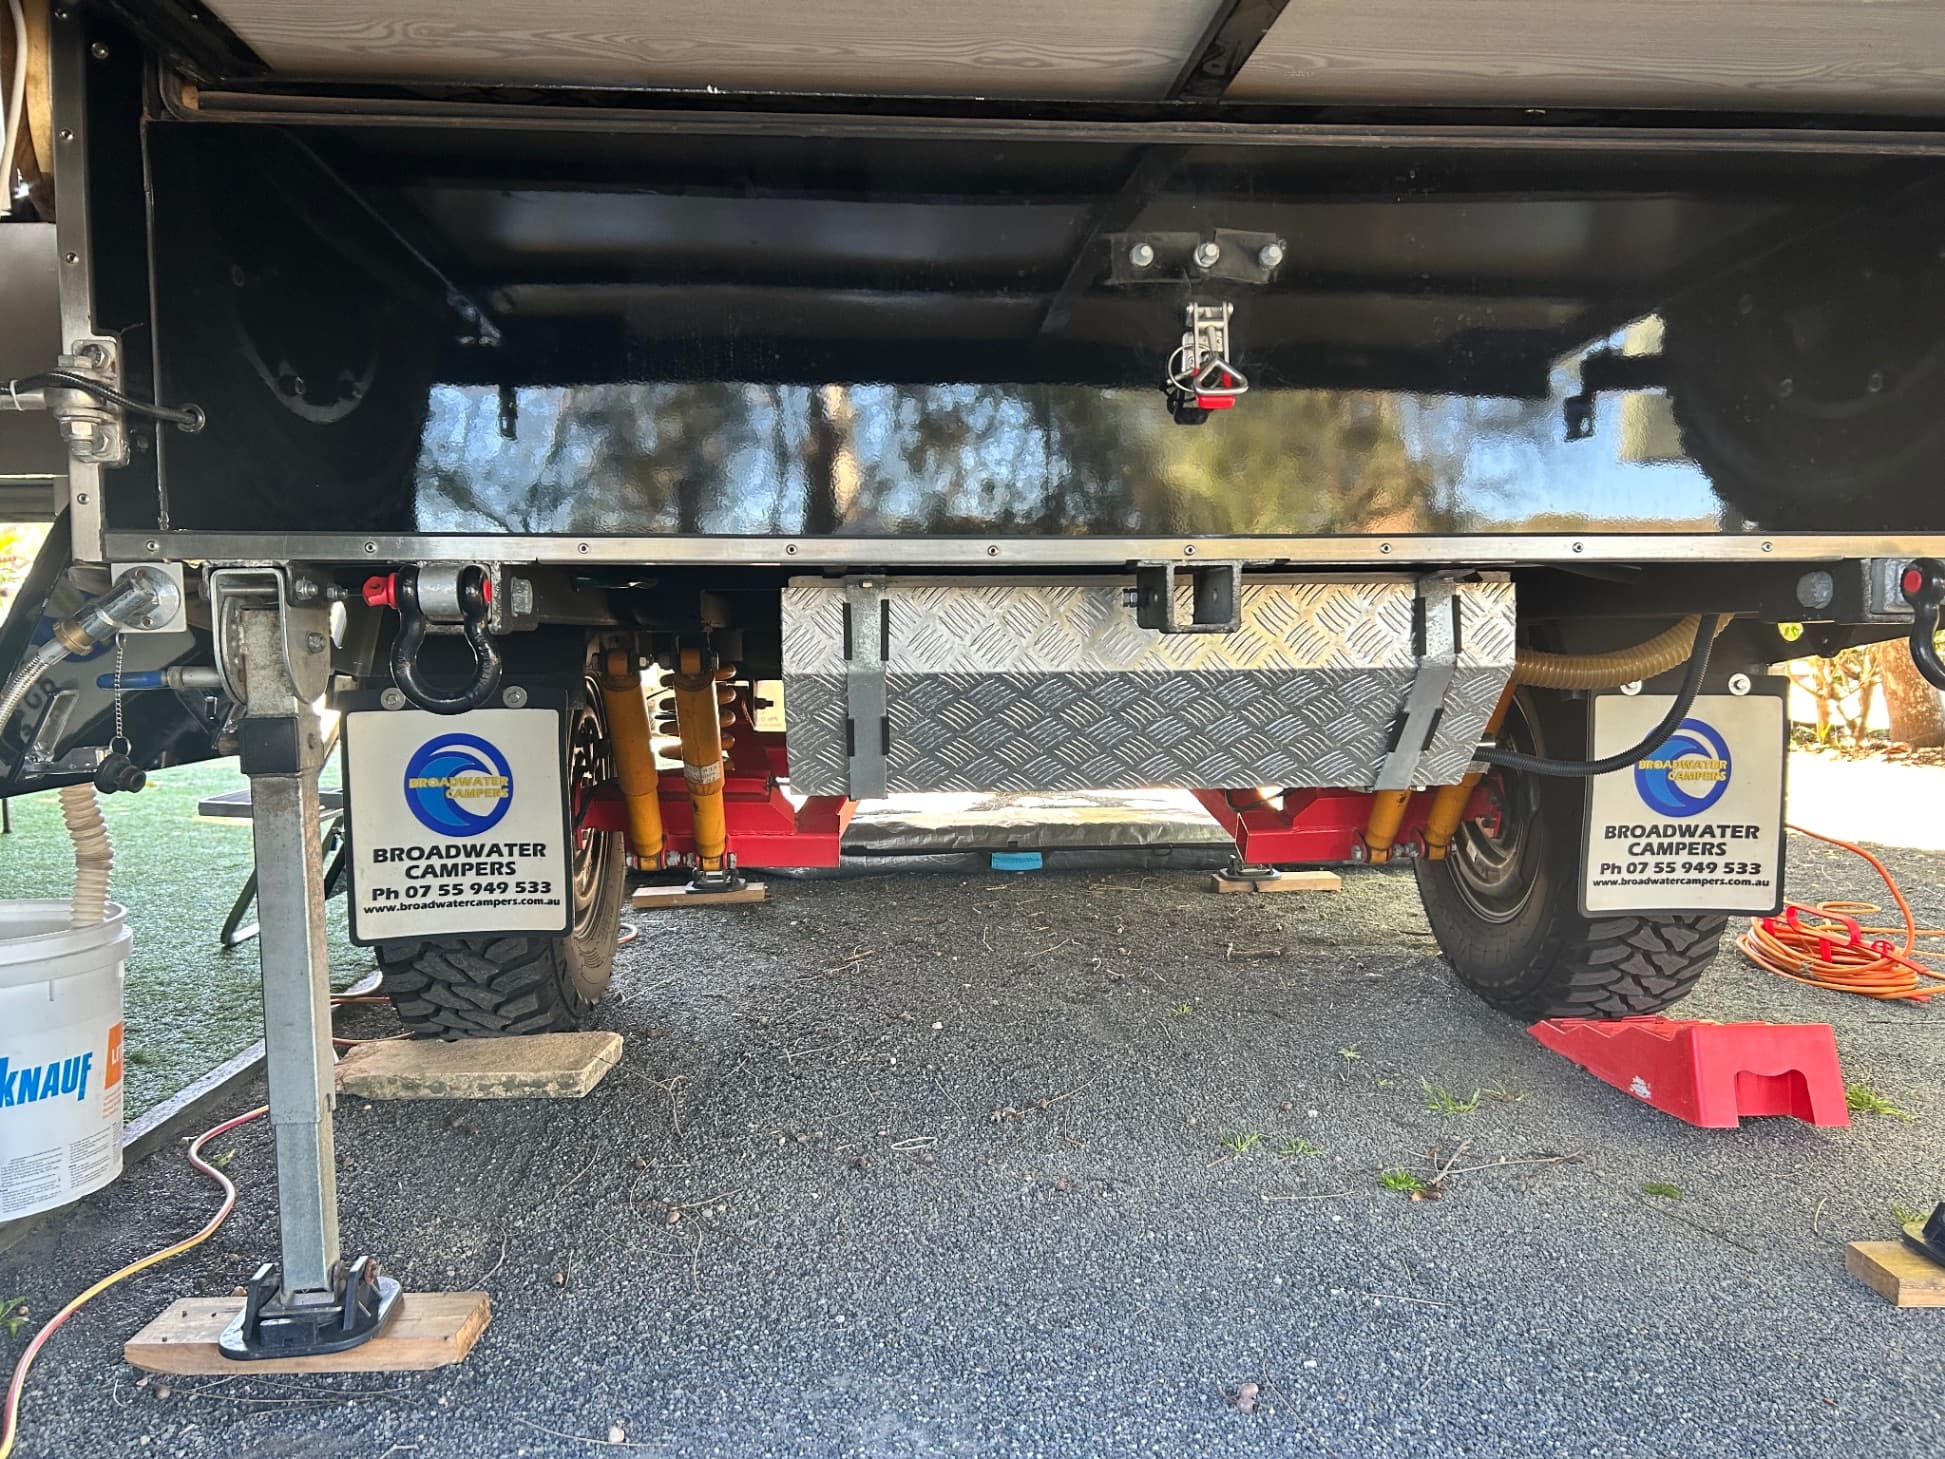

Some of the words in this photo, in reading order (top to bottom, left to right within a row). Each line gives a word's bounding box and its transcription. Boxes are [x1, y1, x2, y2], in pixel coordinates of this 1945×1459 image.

[1639, 760, 1727, 770] BROADWATER
[409, 776, 509, 789] BROADWATER
[1667, 771, 1727, 781] CAMPERS
[446, 788, 509, 799] CAMPERS
[1604, 824, 1759, 839] BROADWATER
[373, 843, 546, 863] BROADWATER
[1627, 842, 1727, 856] CAMPERS
[405, 861, 516, 880] CAMPERS
[1600, 862, 1622, 875] Ph
[1626, 862, 1650, 875] 07
[1653, 862, 1676, 874] 55
[1681, 862, 1718, 874] 949
[1723, 862, 1761, 875] 533
[1593, 877, 1769, 887] www.broadwatercampers.com.au
[372, 887, 399, 901] Ph
[405, 884, 431, 899] 07
[438, 884, 464, 897] 55
[470, 882, 508, 895] 949
[515, 881, 551, 894] 533
[364, 898, 560, 914] www.broadwatercampers.com.au
[0, 1051, 94, 1108] KNAUF
